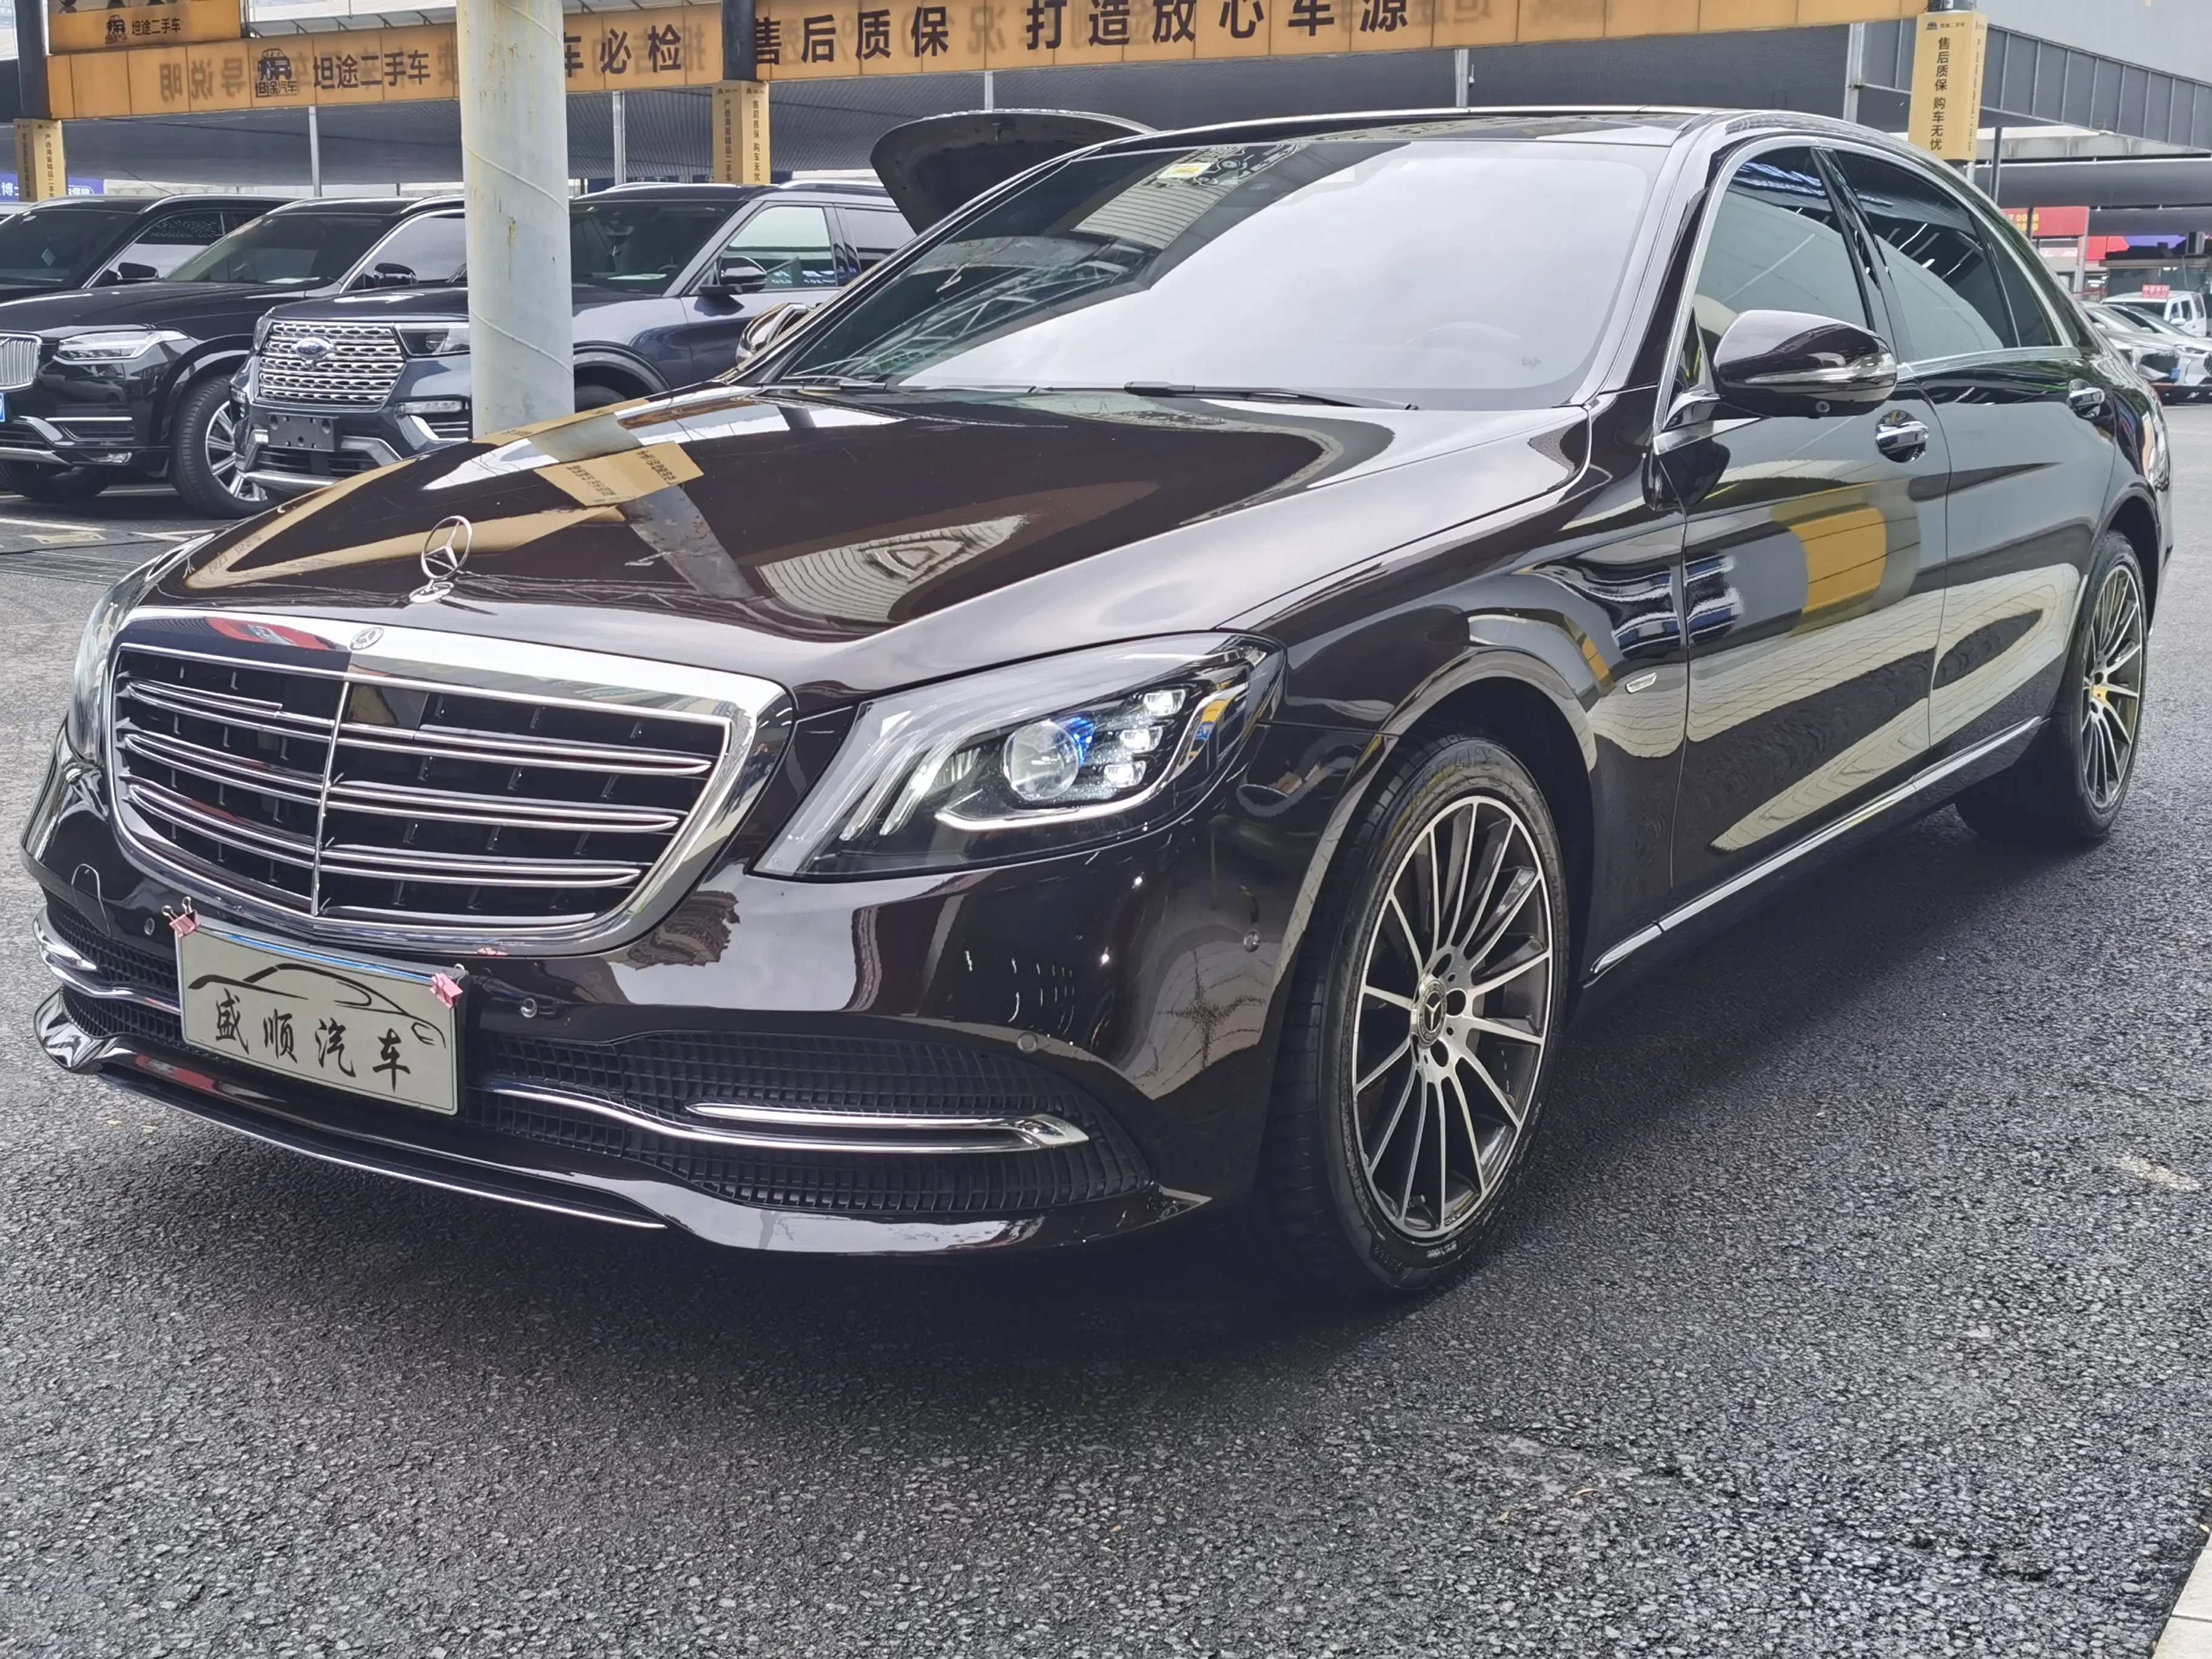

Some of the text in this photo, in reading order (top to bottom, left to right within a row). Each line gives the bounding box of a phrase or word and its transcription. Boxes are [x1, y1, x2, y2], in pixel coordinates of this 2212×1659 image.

[132, 17, 181, 36] 坦途二手车
[313, 50, 431, 89] 坦途二手车
[1930, 37, 1951, 151] 售后质保 购车无忧
[215, 987, 412, 1092] 盛顺汽车
